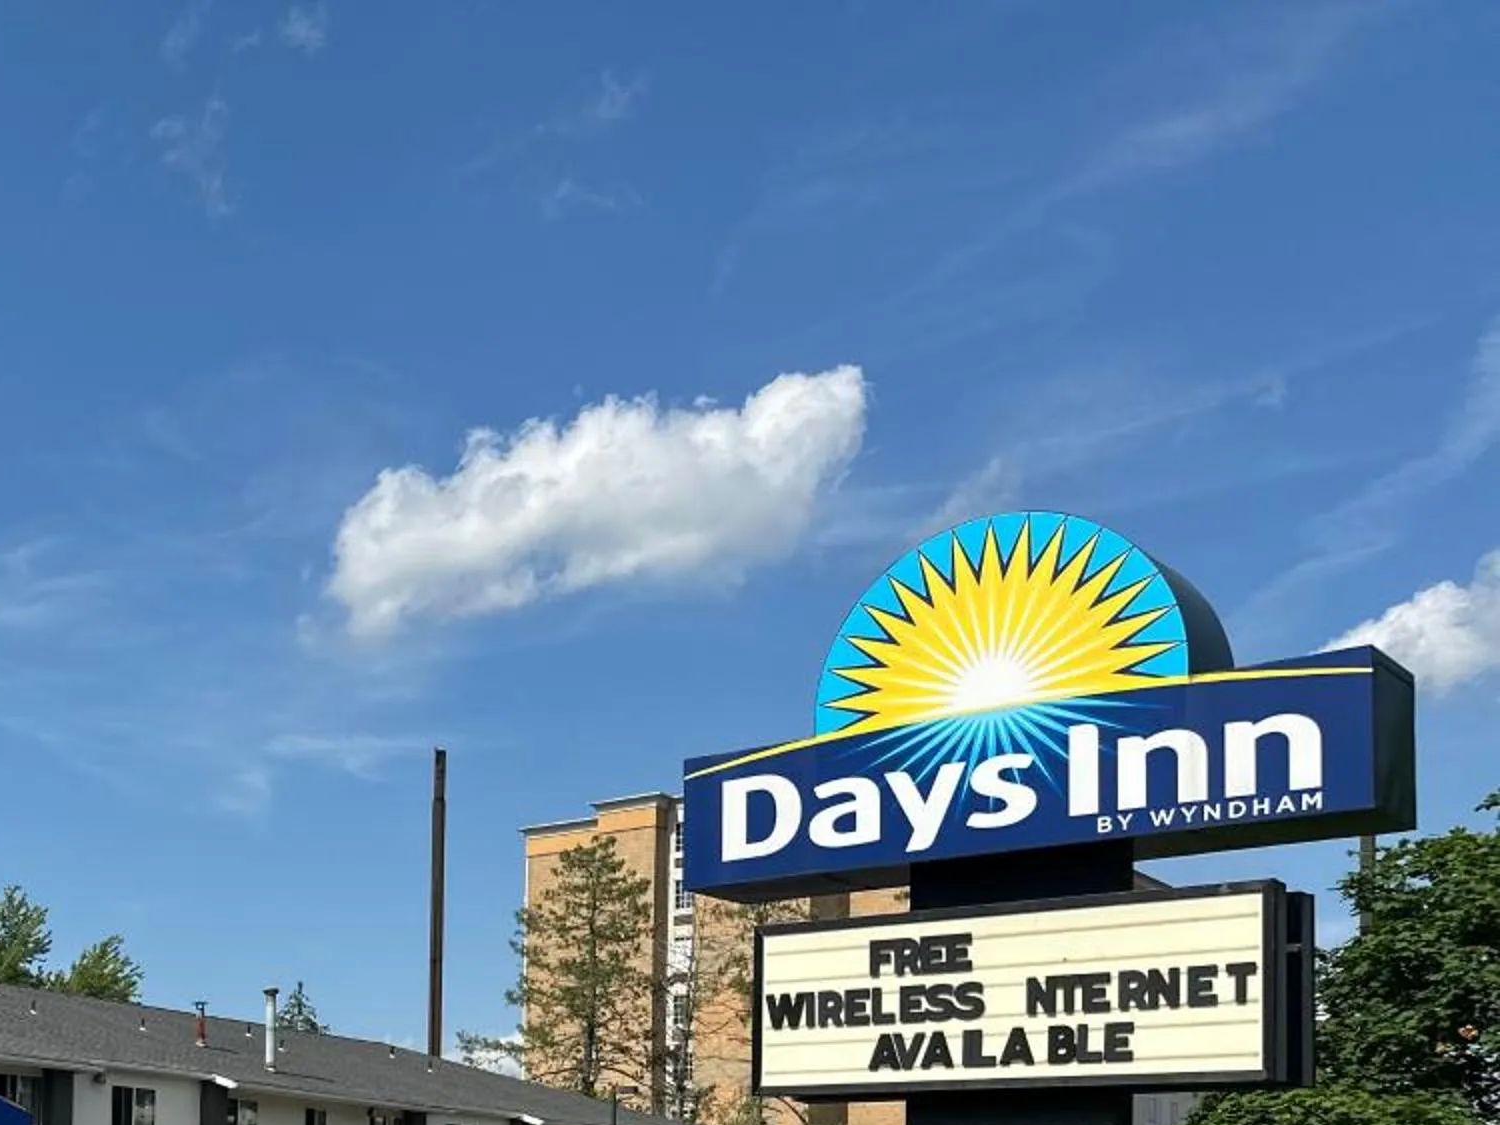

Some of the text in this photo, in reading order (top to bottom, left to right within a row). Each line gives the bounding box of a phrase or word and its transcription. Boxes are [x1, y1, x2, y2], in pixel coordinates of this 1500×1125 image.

[721, 713, 1323, 862] Days Inn
[1097, 791, 1323, 833] BY WYNDHAM
[869, 933, 973, 979] FREE
[766, 961, 1257, 1030] WIRELESS NTERNET
